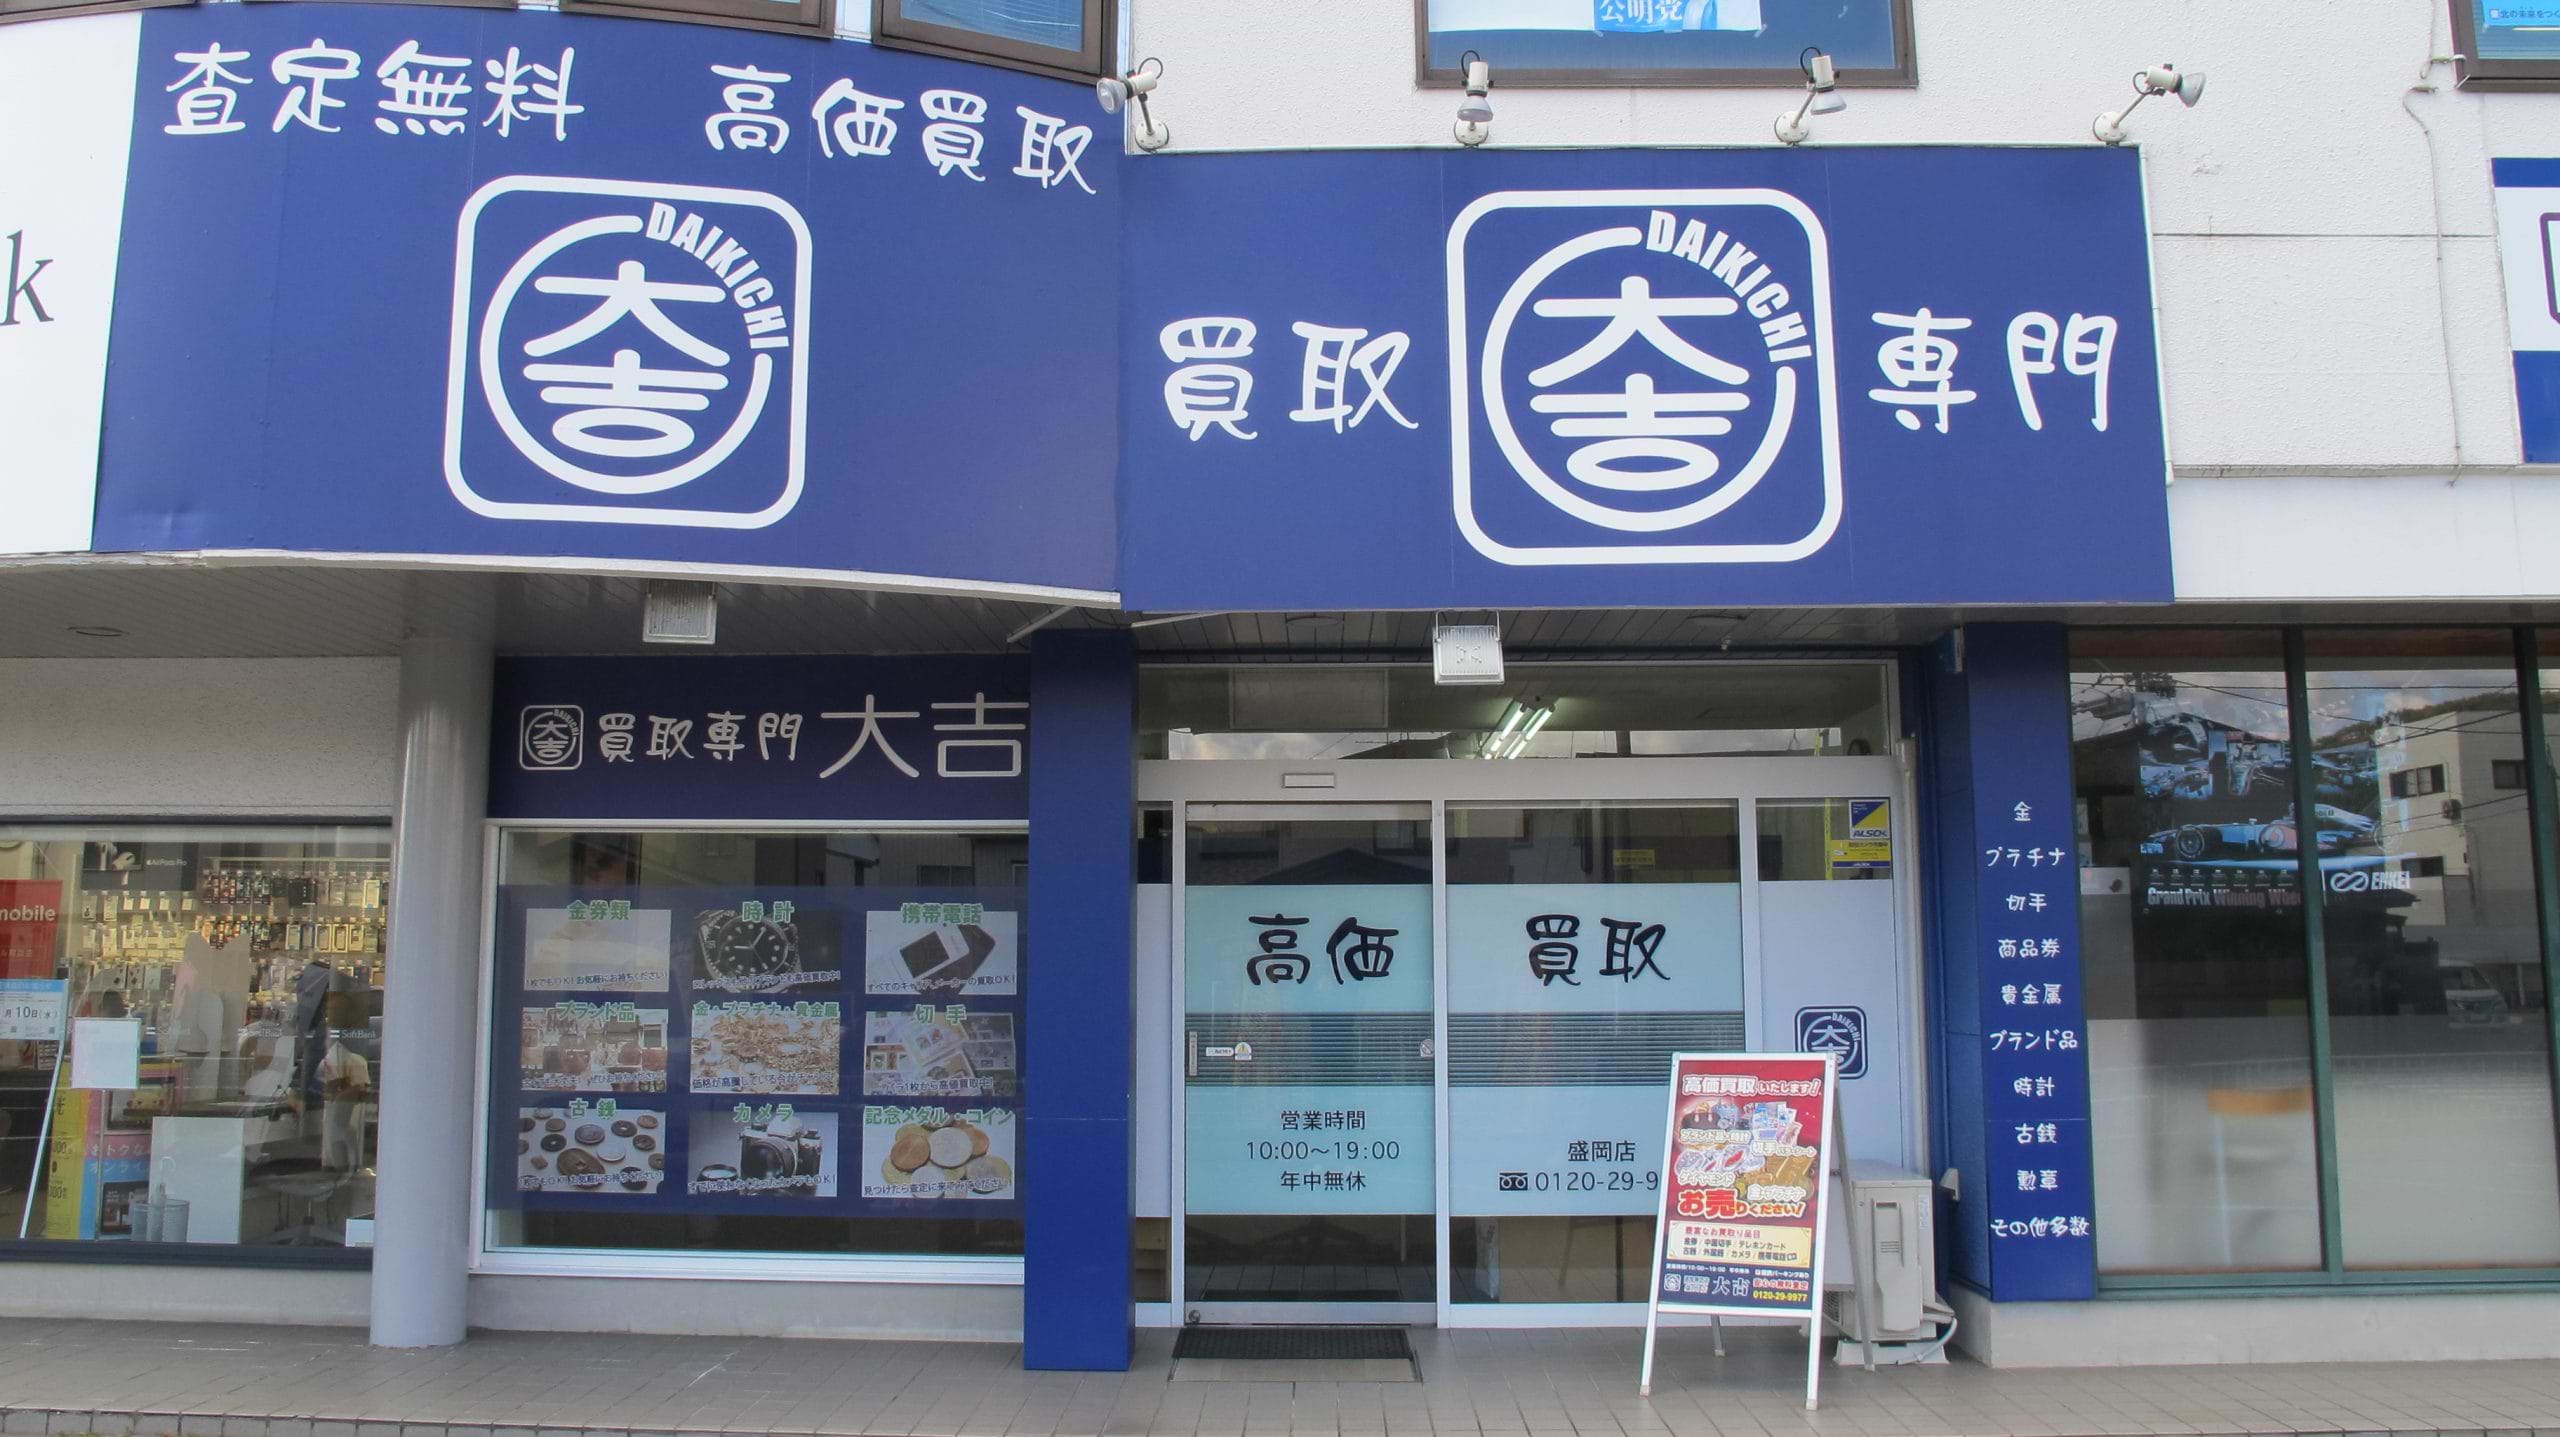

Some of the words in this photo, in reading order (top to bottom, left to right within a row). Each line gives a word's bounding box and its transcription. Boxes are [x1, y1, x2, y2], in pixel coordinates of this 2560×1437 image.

[1599, 0, 1684, 24] 公明党
[164, 38, 586, 141] 査定無料
[705, 64, 1097, 195] 高価買取
[0, 229, 55, 326] k
[646, 201, 790, 350] DAIKICHI
[1647, 209, 1812, 364] DAIKICHI
[523, 260, 731, 458] 大吉
[1159, 317, 1420, 441] 買取
[1868, 307, 2117, 434] 専門
[1528, 276, 1751, 492] 大吉
[599, 711, 803, 763] 買取専門
[819, 692, 1030, 779] 大吉
[2013, 801, 2032, 822] 金
[1852, 829, 1888, 838] ALSOK
[1985, 846, 2066, 867] プラチナ
[2371, 870, 2411, 891] ENKEI
[2005, 893, 2048, 913] 切手
[2148, 887, 2184, 906] Grand
[2184, 888, 2212, 906] Prix
[567, 899, 632, 922] 金券類
[741, 900, 796, 923] 時計
[901, 902, 984, 925] 携帯電話
[1246, 913, 1400, 986] 高価
[1526, 914, 1671, 987] 買取
[1998, 938, 2061, 959] 商品券
[2000, 983, 2063, 1005] 貴金属
[556, 1000, 638, 1023] ブランド品
[914, 1004, 968, 1025] 切手
[341, 1029, 377, 1038] SoftBank
[1832, 1012, 1862, 1041] DAIKICHI
[1989, 1030, 2079, 1051] ブランド品
[2013, 1076, 2056, 1097] 時計
[733, 1102, 796, 1123] カメラ
[864, 1105, 1016, 1126] 記念メダル・コイン
[1280, 1110, 1367, 1131] 営業時間
[2014, 1122, 2058, 1144] 古銭
[1246, 1140, 1401, 1160] 10:00～19:00
[1567, 1140, 1637, 1163] 盛岡店
[1280, 1170, 1367, 1192] 年中無休
[2016, 1169, 2059, 1191] 勲章
[1678, 1189, 1807, 1219] お売りください!
[1989, 1216, 2091, 1238] その他多数
